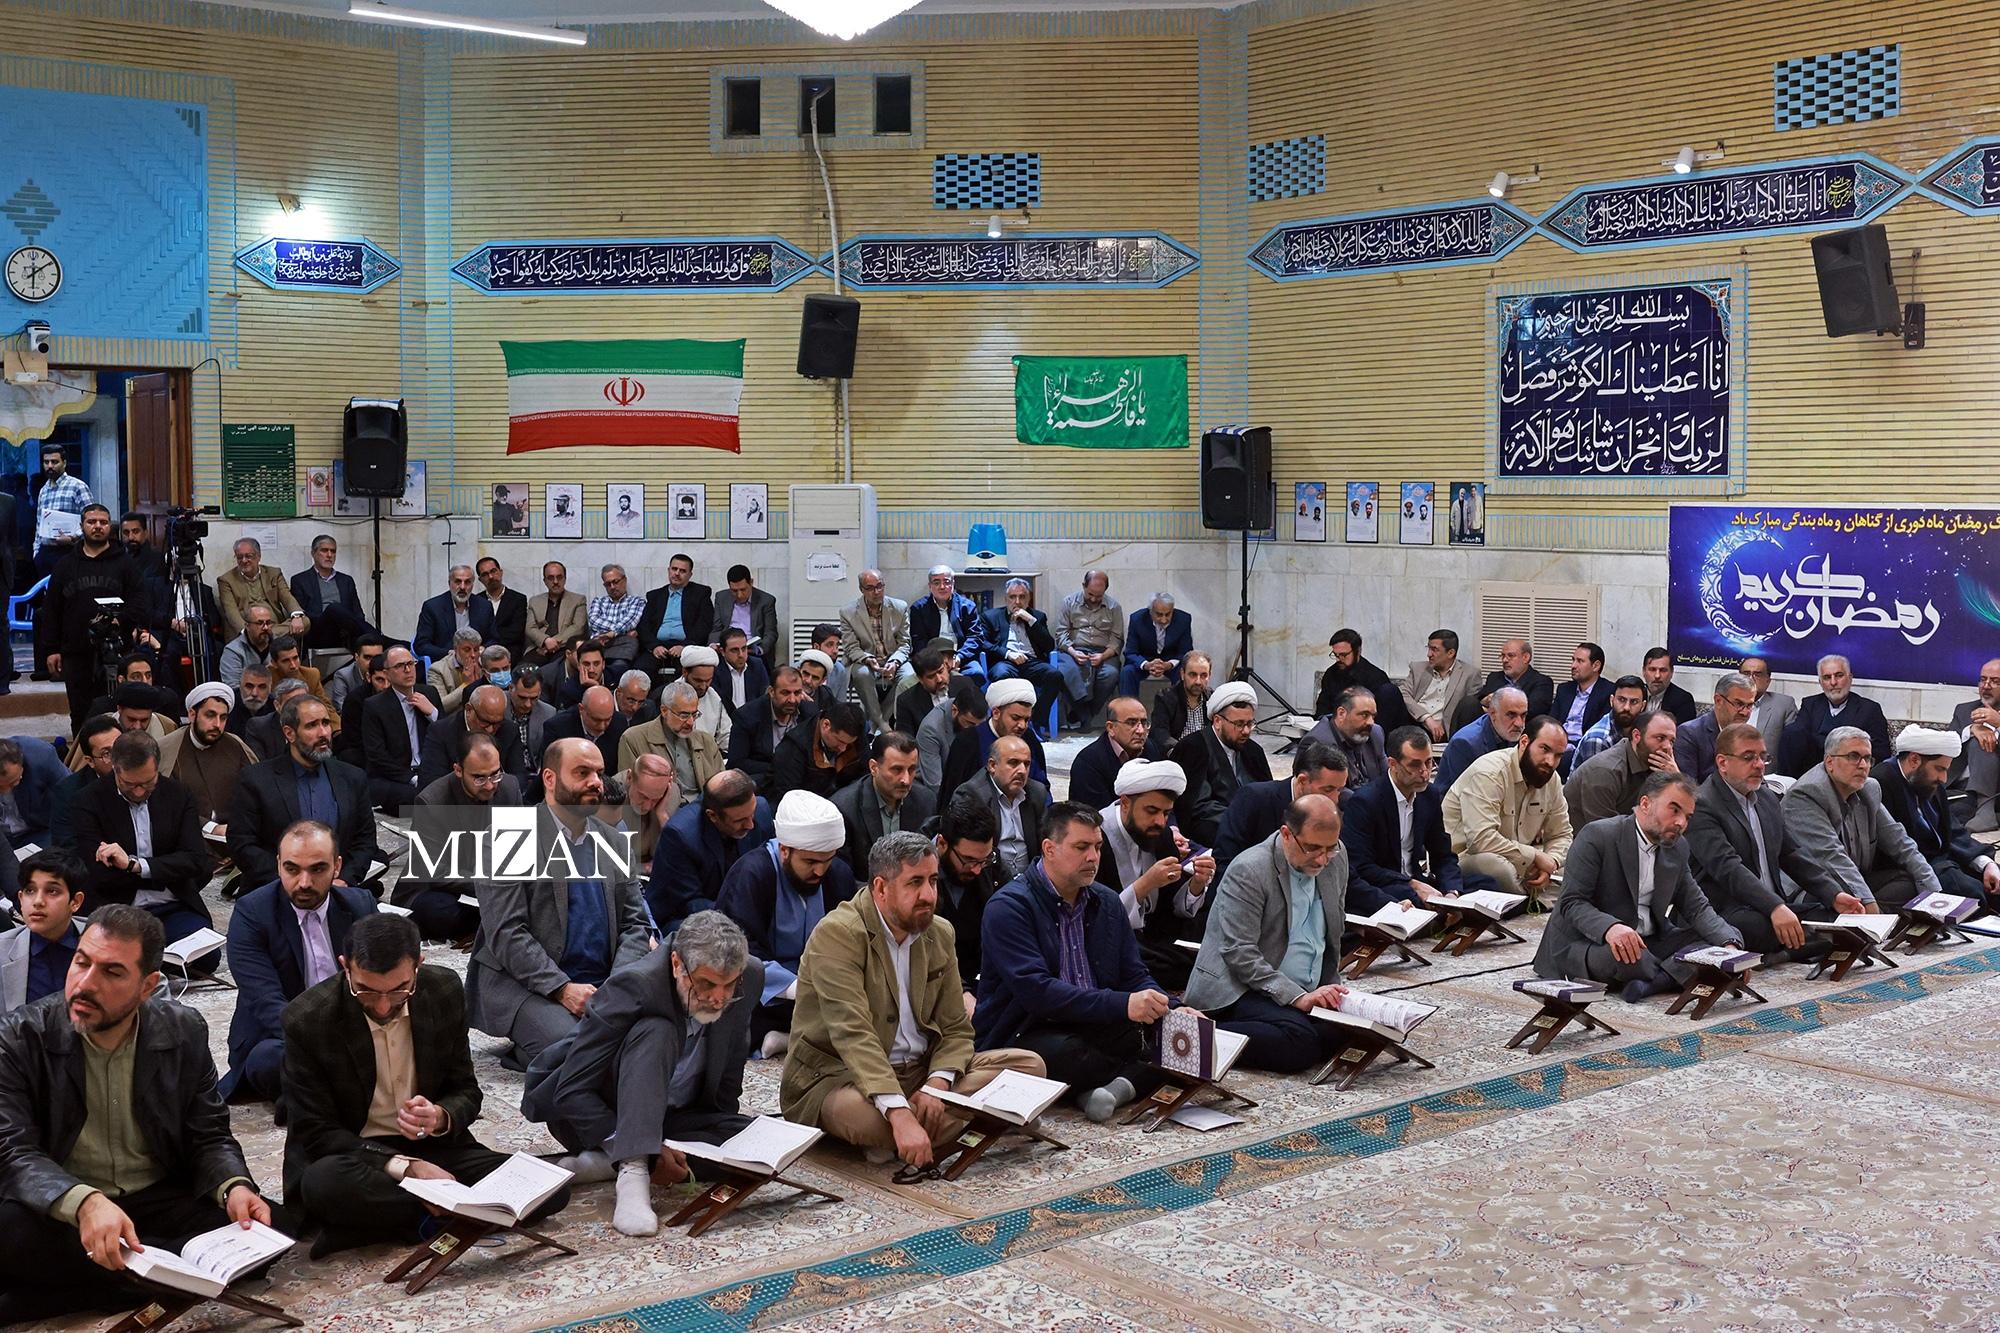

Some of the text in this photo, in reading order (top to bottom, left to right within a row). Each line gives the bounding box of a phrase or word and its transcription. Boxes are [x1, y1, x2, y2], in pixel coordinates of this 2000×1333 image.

[1749, 511, 1781, 530] مبارک
[1781, 511, 1817, 531] بندگی
[1817, 512, 1834, 527] ماه
[1844, 513, 1883, 532] گناهان
[1883, 513, 1894, 533] از
[1926, 514, 1944, 529] ماه
[1945, 513, 1988, 534] رمضان
[1784, 553, 1940, 645] رمضان
[1677, 654, 1690, 663] مسلح
[1721, 657, 1738, 666] سازمان
